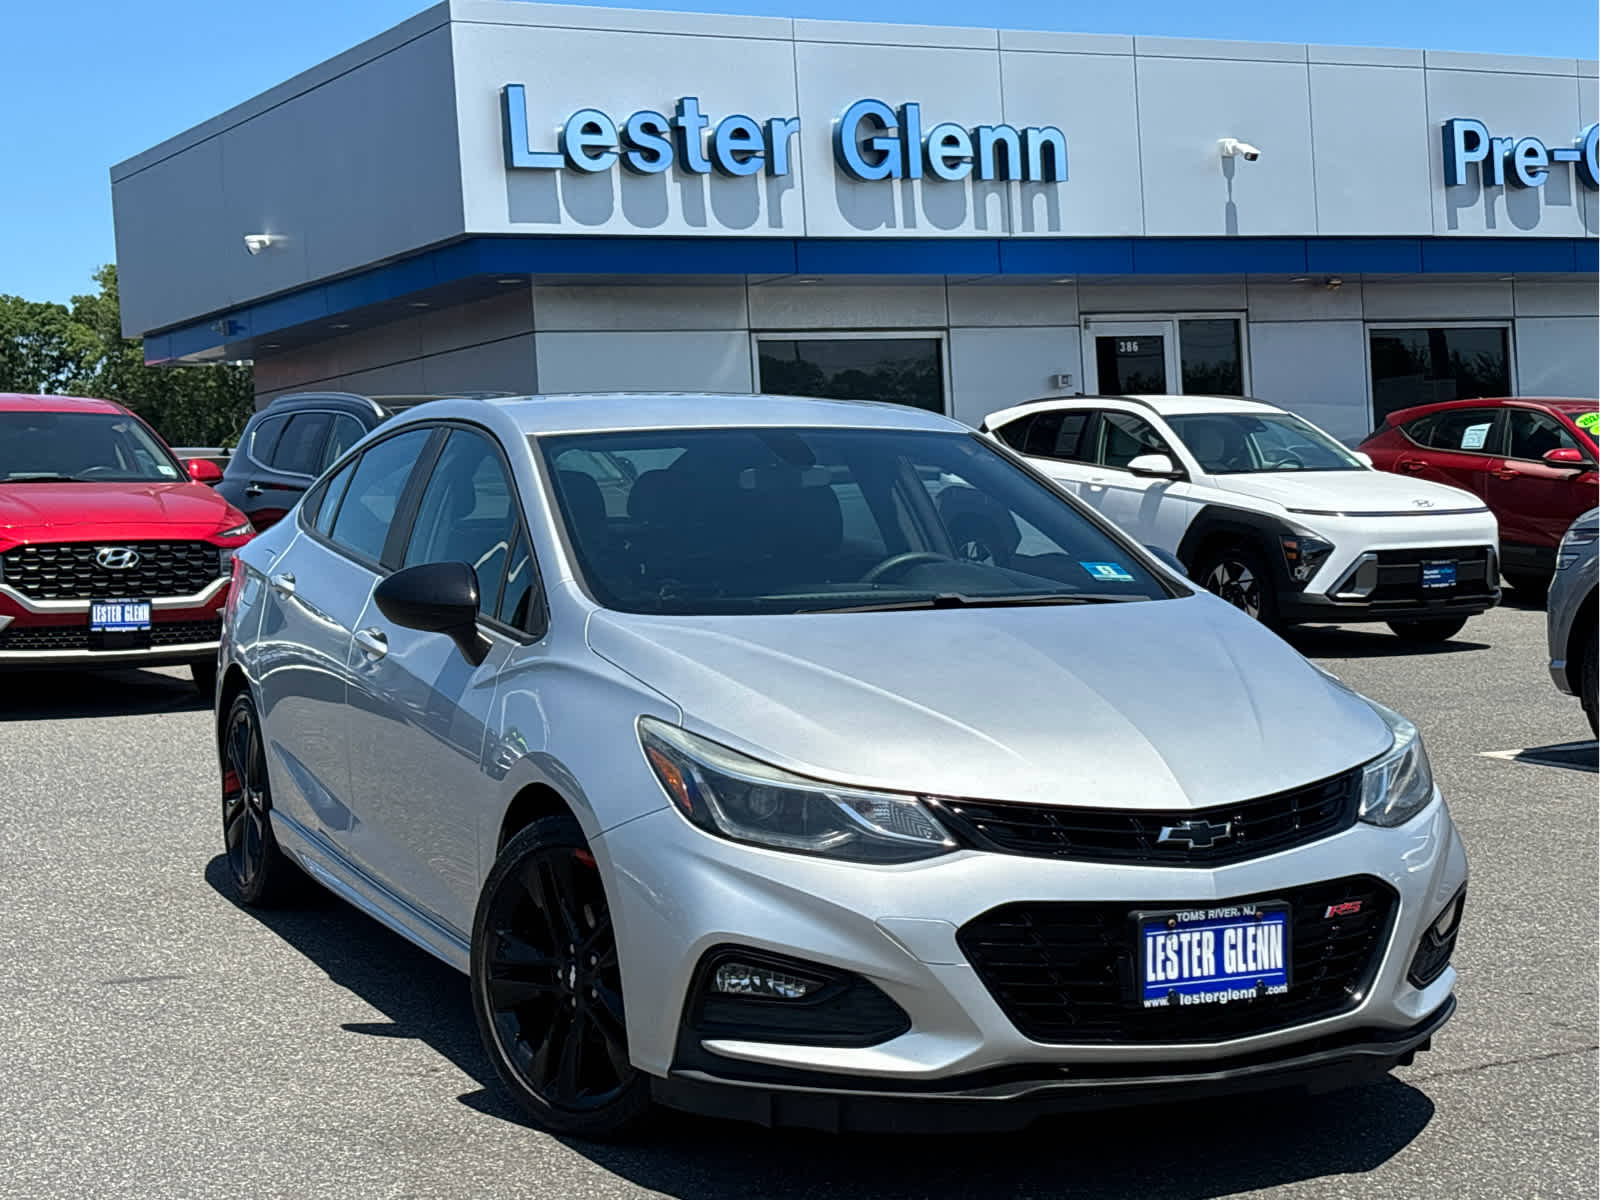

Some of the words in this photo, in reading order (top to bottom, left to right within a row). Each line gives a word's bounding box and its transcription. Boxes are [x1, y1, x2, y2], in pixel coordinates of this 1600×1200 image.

[501, 84, 800, 177] Lester
[832, 99, 1068, 182] Glenn
[1120, 341, 1139, 352] 386
[92, 604, 122, 622] LESTER
[124, 604, 150, 621] GLENN
[1176, 911, 1206, 922] TOMS
[1243, 904, 1257, 916] NJ
[1324, 900, 1363, 919] RS
[1146, 930, 1216, 982] LESTER
[1223, 924, 1283, 974] GLENN
